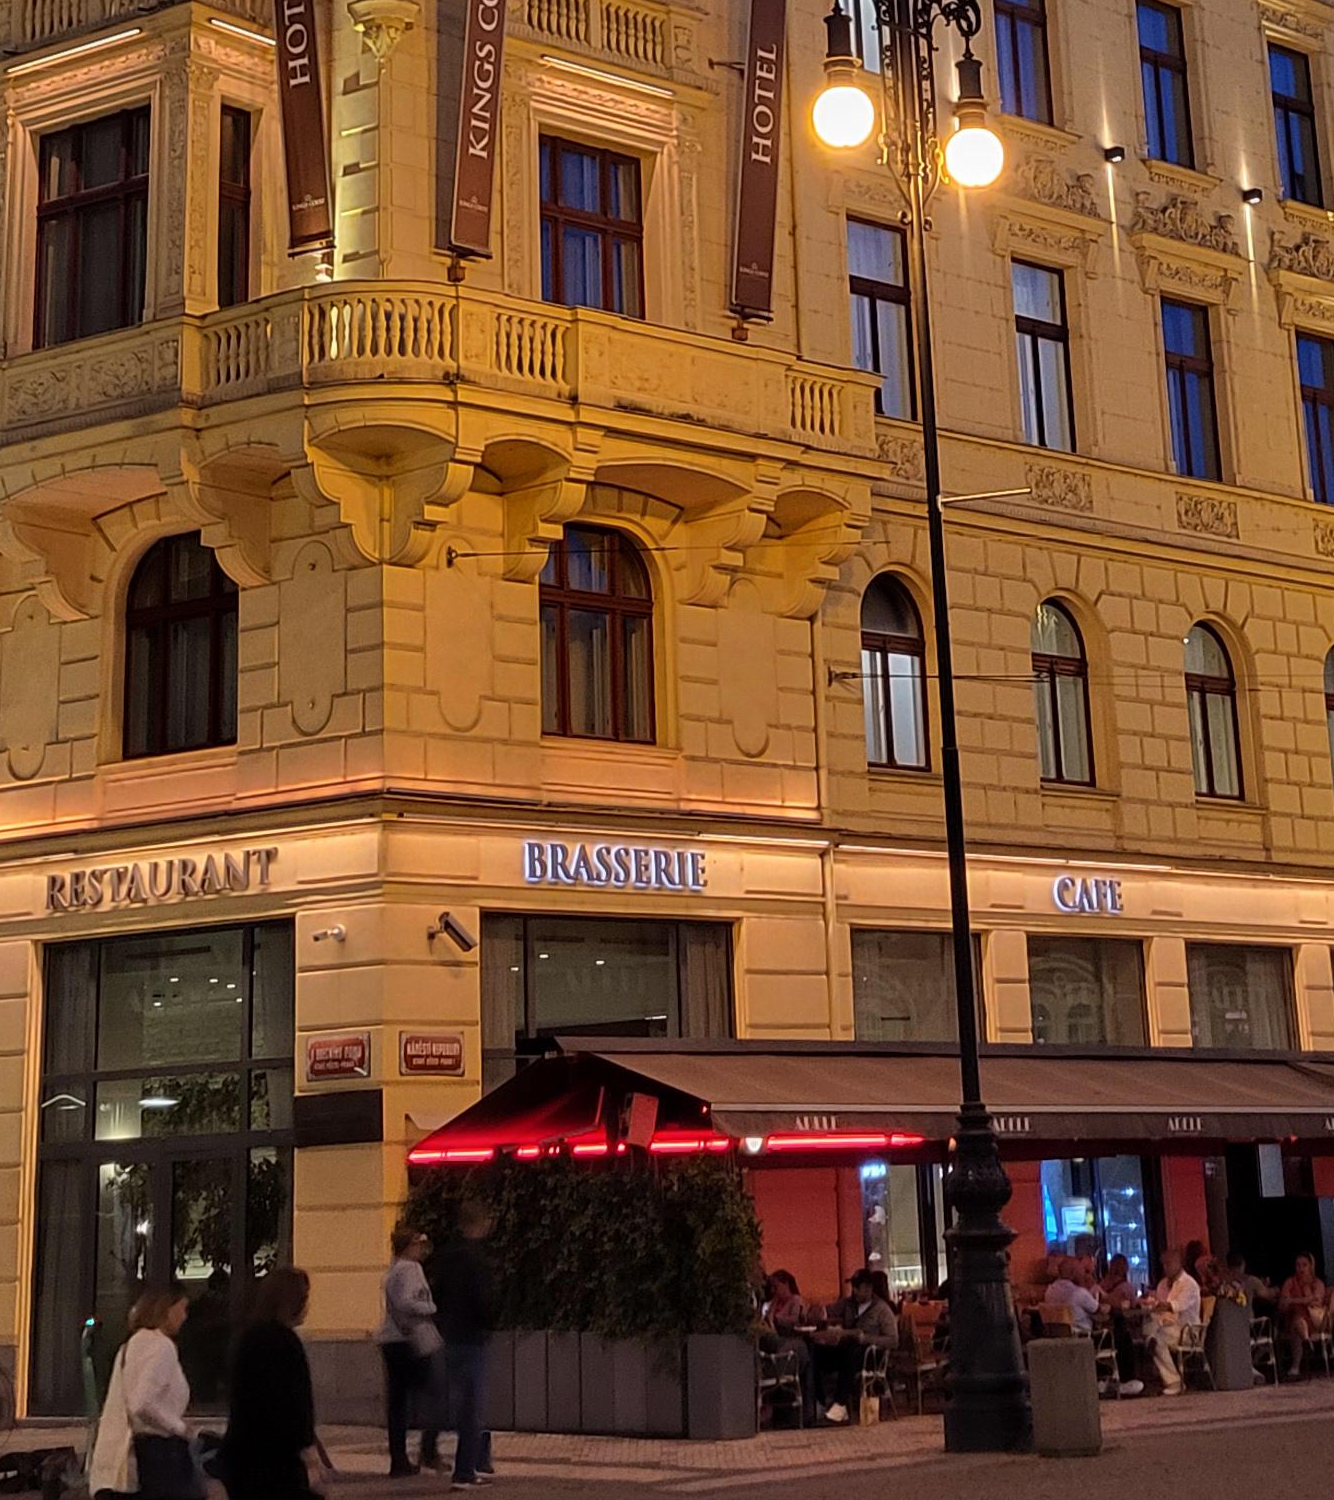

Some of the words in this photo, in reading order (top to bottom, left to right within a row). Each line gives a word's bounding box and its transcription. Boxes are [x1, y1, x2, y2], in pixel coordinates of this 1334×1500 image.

[468, 40, 496, 160] KINGS
[750, 43, 778, 165] HOTEL
[45, 846, 279, 911] RESTAURANT
[524, 840, 709, 890] BRASSERIE
[1053, 875, 1124, 915] CAFE
